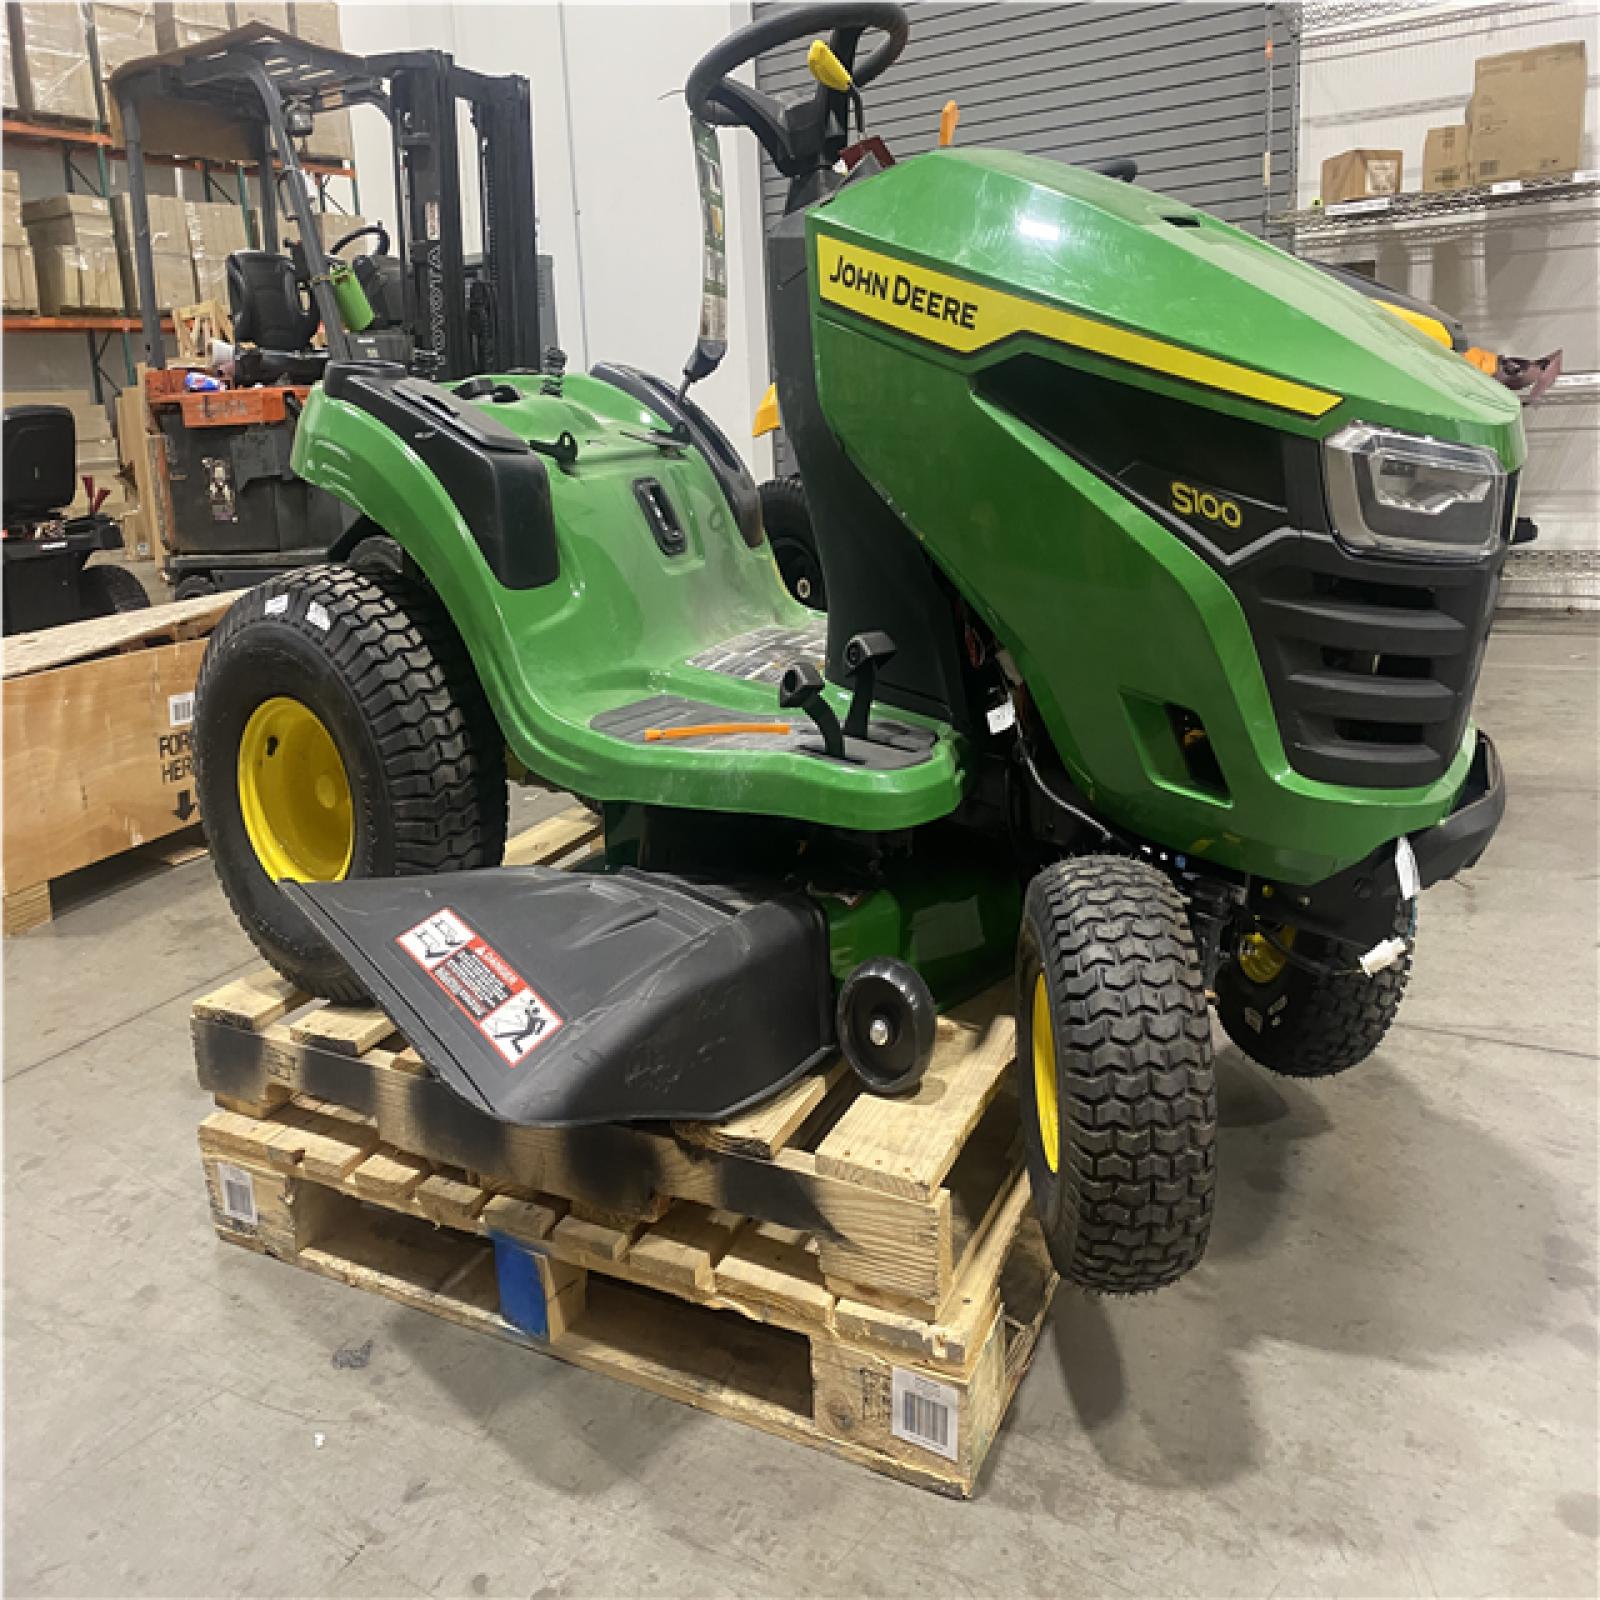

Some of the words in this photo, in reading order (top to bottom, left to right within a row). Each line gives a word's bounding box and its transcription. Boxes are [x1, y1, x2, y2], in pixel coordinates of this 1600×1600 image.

[829, 254, 888, 301] JOHN
[892, 274, 978, 331] DEERE
[1171, 480, 1241, 529] S100
[159, 731, 191, 759] FOR
[161, 756, 194, 783] HER
